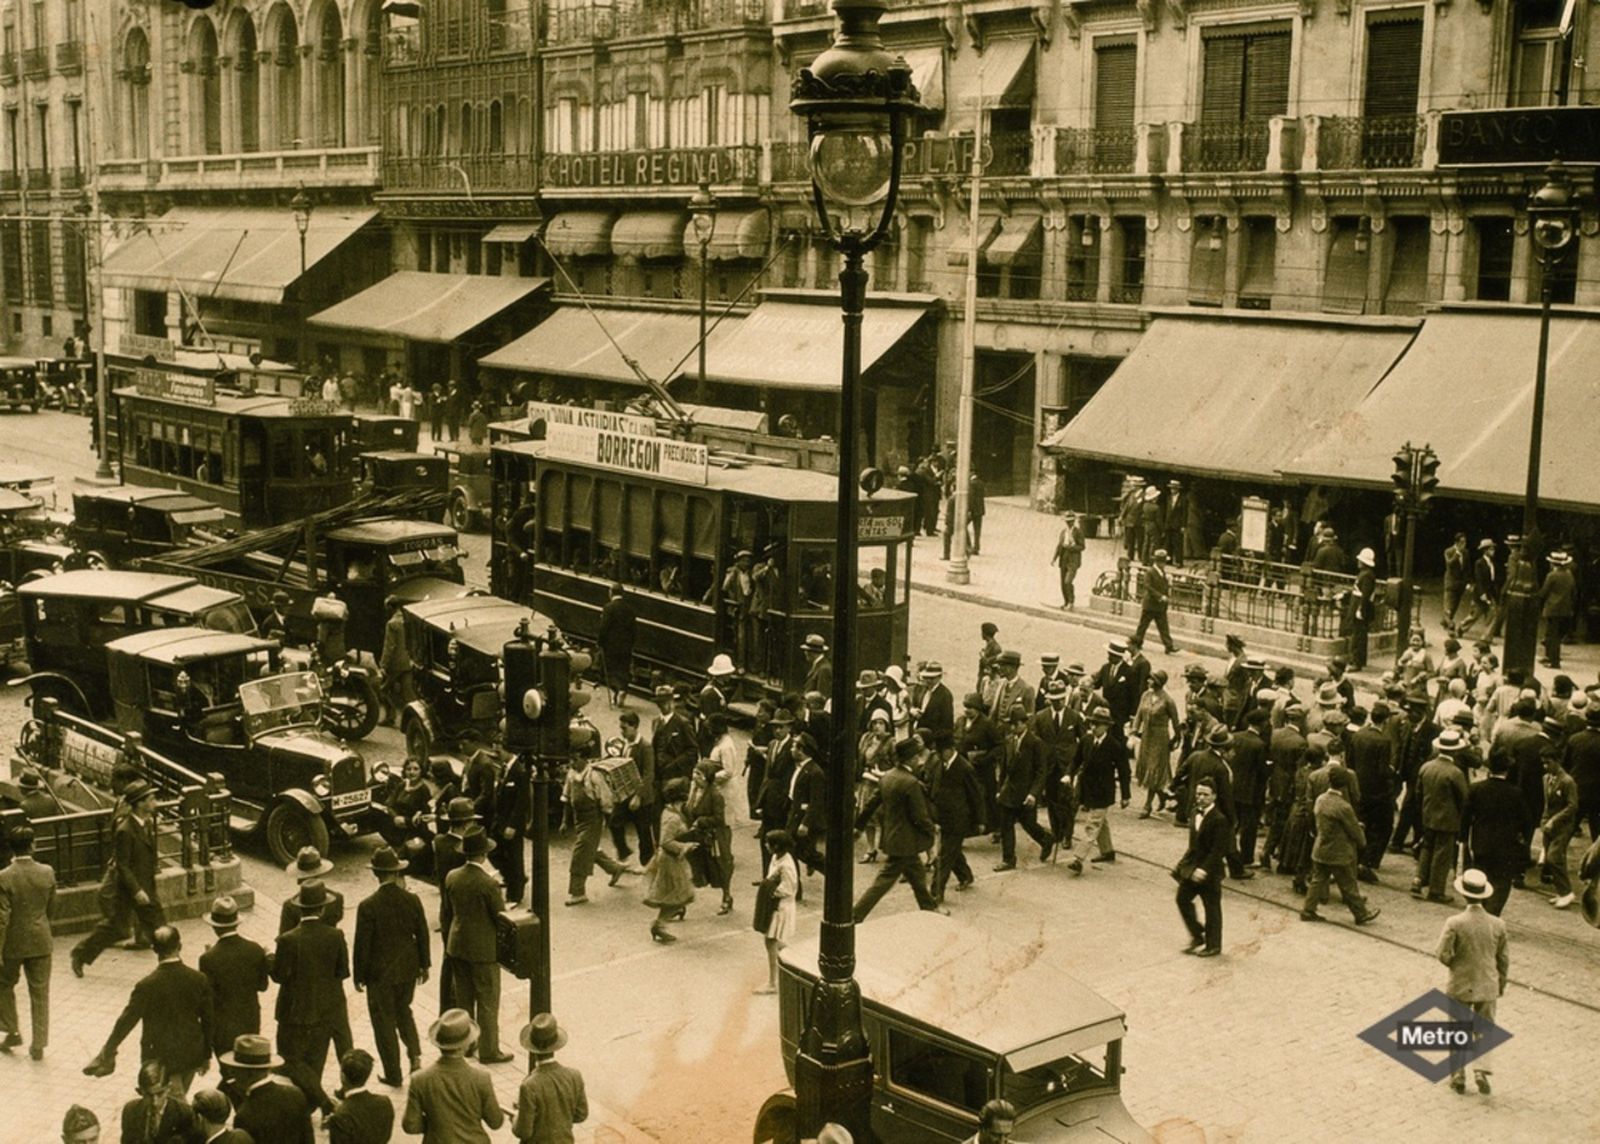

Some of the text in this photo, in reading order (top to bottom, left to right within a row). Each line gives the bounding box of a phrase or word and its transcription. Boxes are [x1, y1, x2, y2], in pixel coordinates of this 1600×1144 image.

[1449, 115, 1556, 147] BANCO
[558, 156, 625, 185] HOTEL
[635, 152, 721, 184] REGINA
[596, 432, 662, 474] BORREGON
[402, 536, 444, 552] TORRAS
[858, 527, 888, 537] ENTAS
